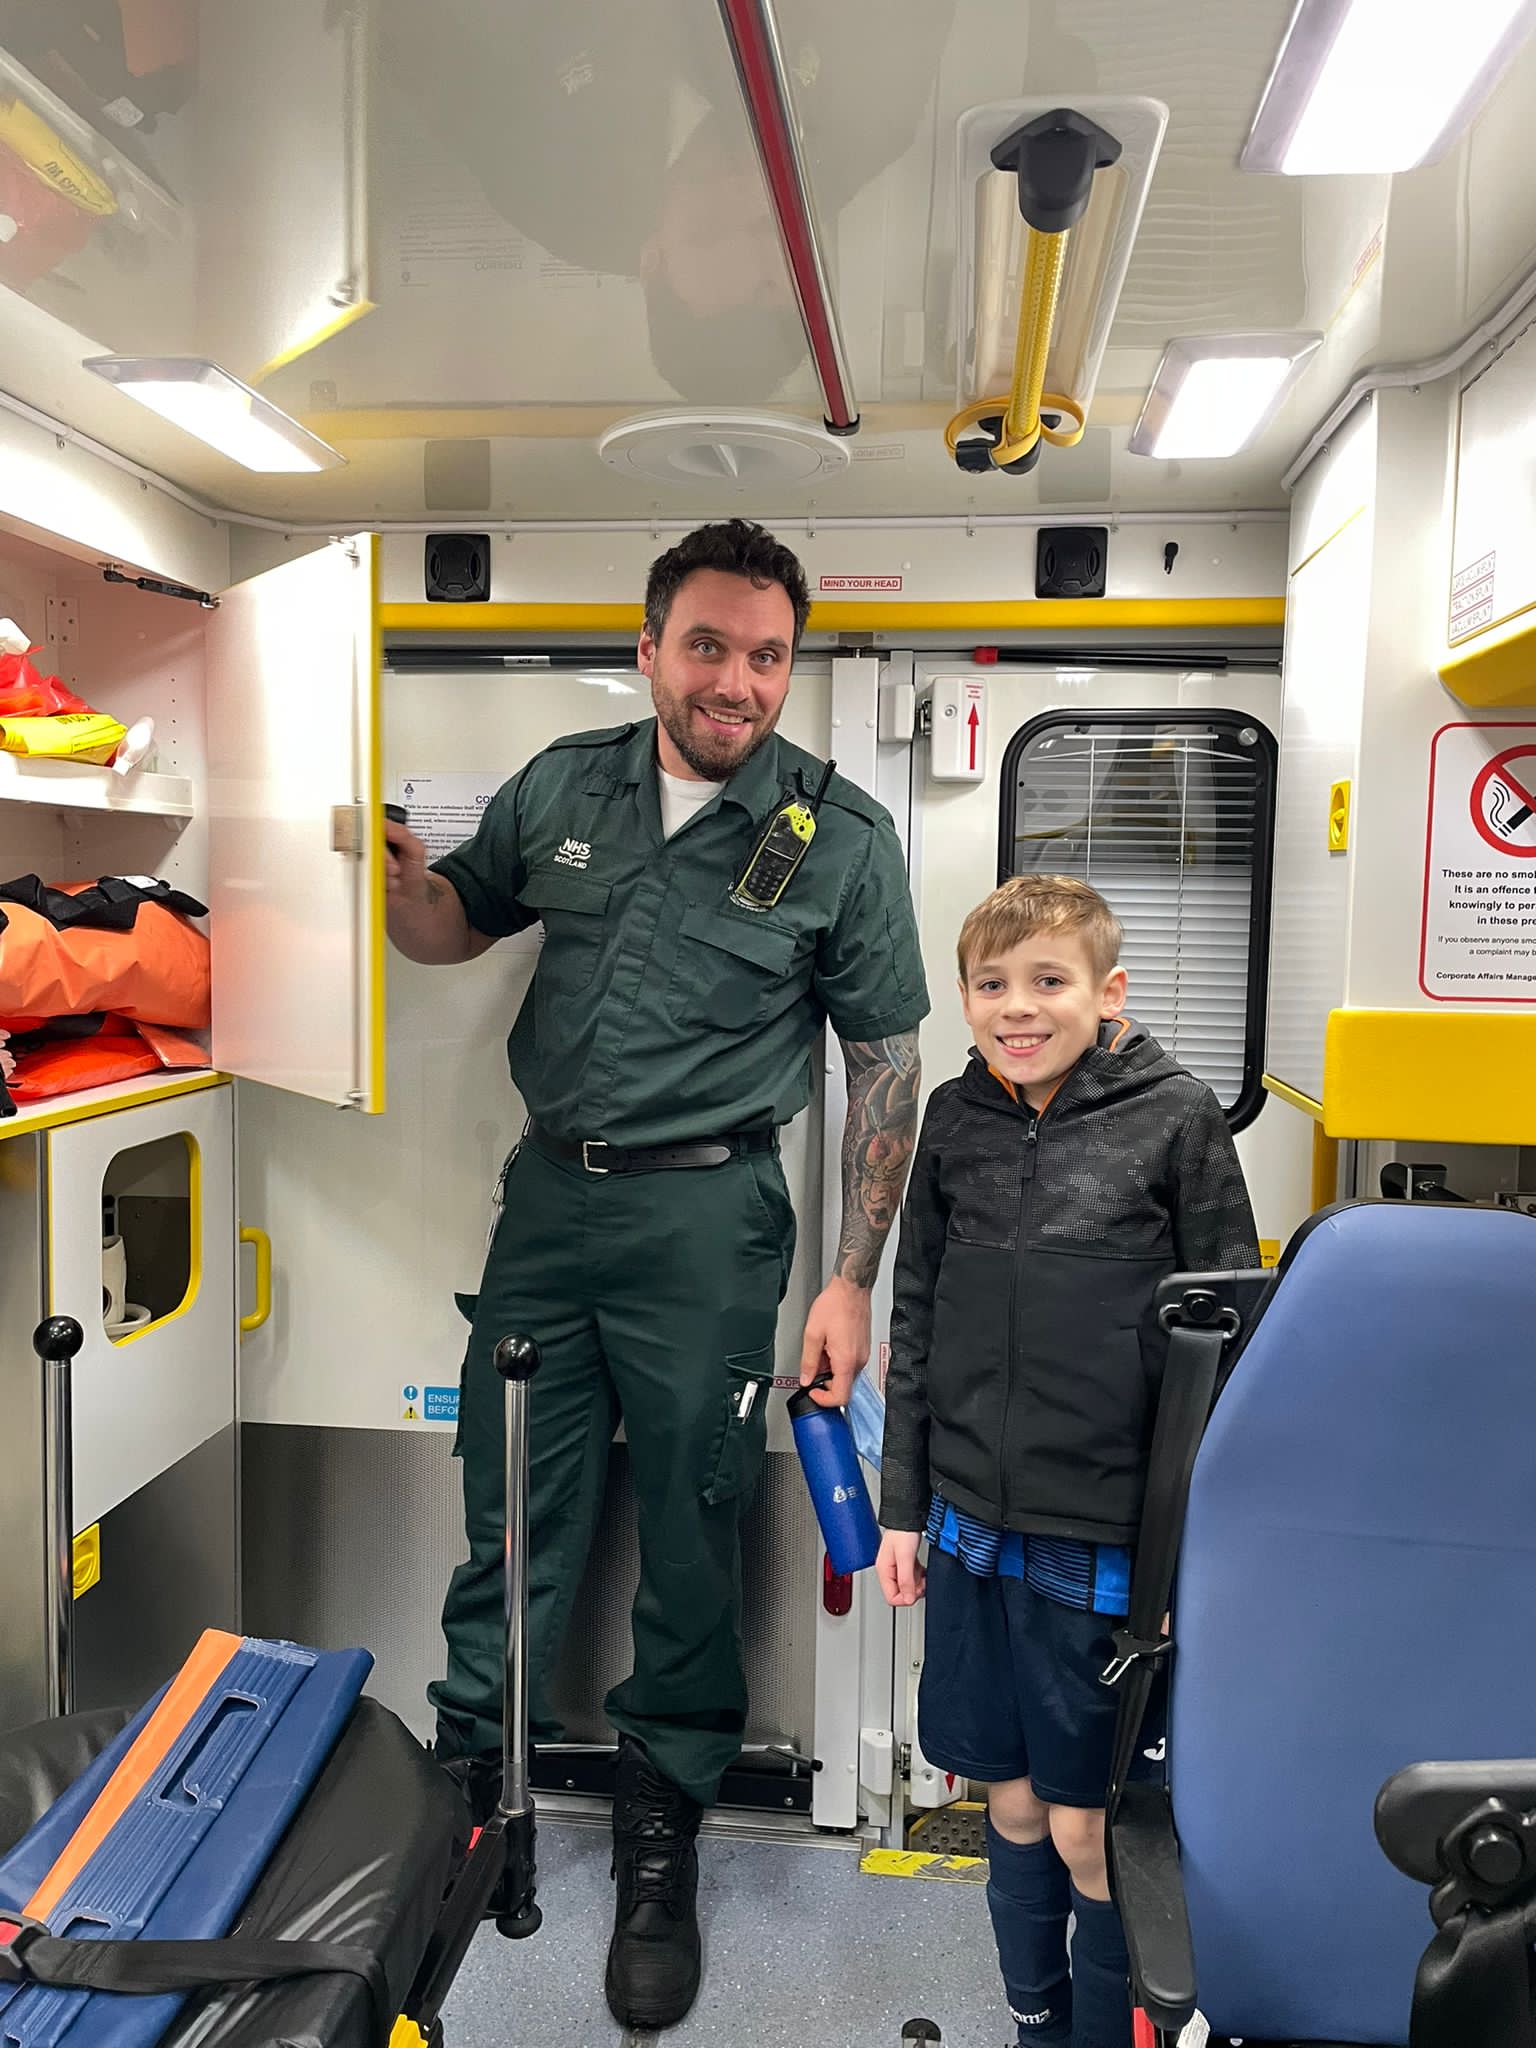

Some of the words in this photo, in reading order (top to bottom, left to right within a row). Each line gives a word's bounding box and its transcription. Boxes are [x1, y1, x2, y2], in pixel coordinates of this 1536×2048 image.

[823, 579, 846, 588] MIND
[847, 579, 872, 588] YOUR
[874, 579, 899, 588] HEAD
[562, 837, 591, 855] NHS
[553, 855, 588, 869] SCOTLAND
[1441, 869, 1473, 878] These
[1454, 885, 1462, 893] It
[1464, 885, 1473, 893] is
[1491, 885, 1531, 894] offence
[1449, 900, 1502, 911] knowingly
[1505, 901, 1515, 909] to
[1518, 903, 1536, 911] per
[1477, 916, 1487, 924] in
[1490, 916, 1518, 925] these
[1491, 937, 1519, 945] anyone
[1476, 948, 1512, 956] complaint
[1436, 971, 1475, 980] Corporate
[1477, 972, 1504, 980] Affairs
